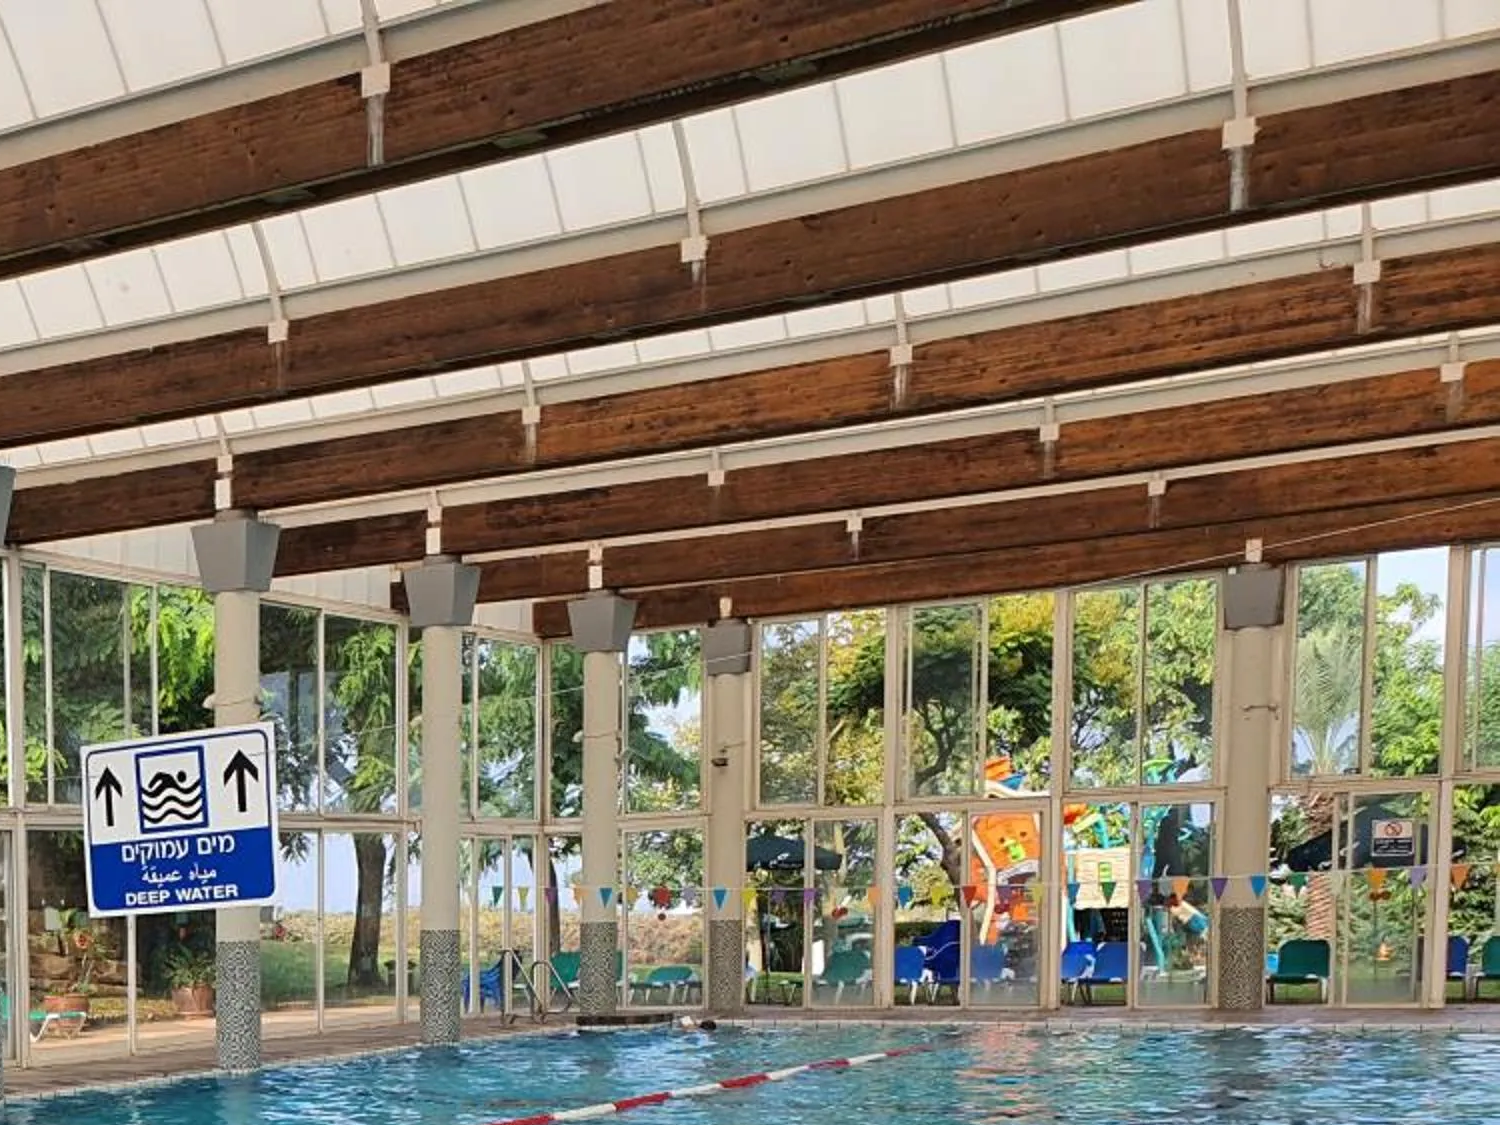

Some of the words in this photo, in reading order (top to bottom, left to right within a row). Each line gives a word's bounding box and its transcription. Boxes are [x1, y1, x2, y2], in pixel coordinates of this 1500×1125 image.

[121, 838, 189, 865] עמוקים
[197, 834, 235, 855] מים
[141, 865, 182, 889] عميقة
[189, 861, 217, 885] مياه
[124, 889, 170, 906] DEEP
[175, 884, 239, 902] WATER
